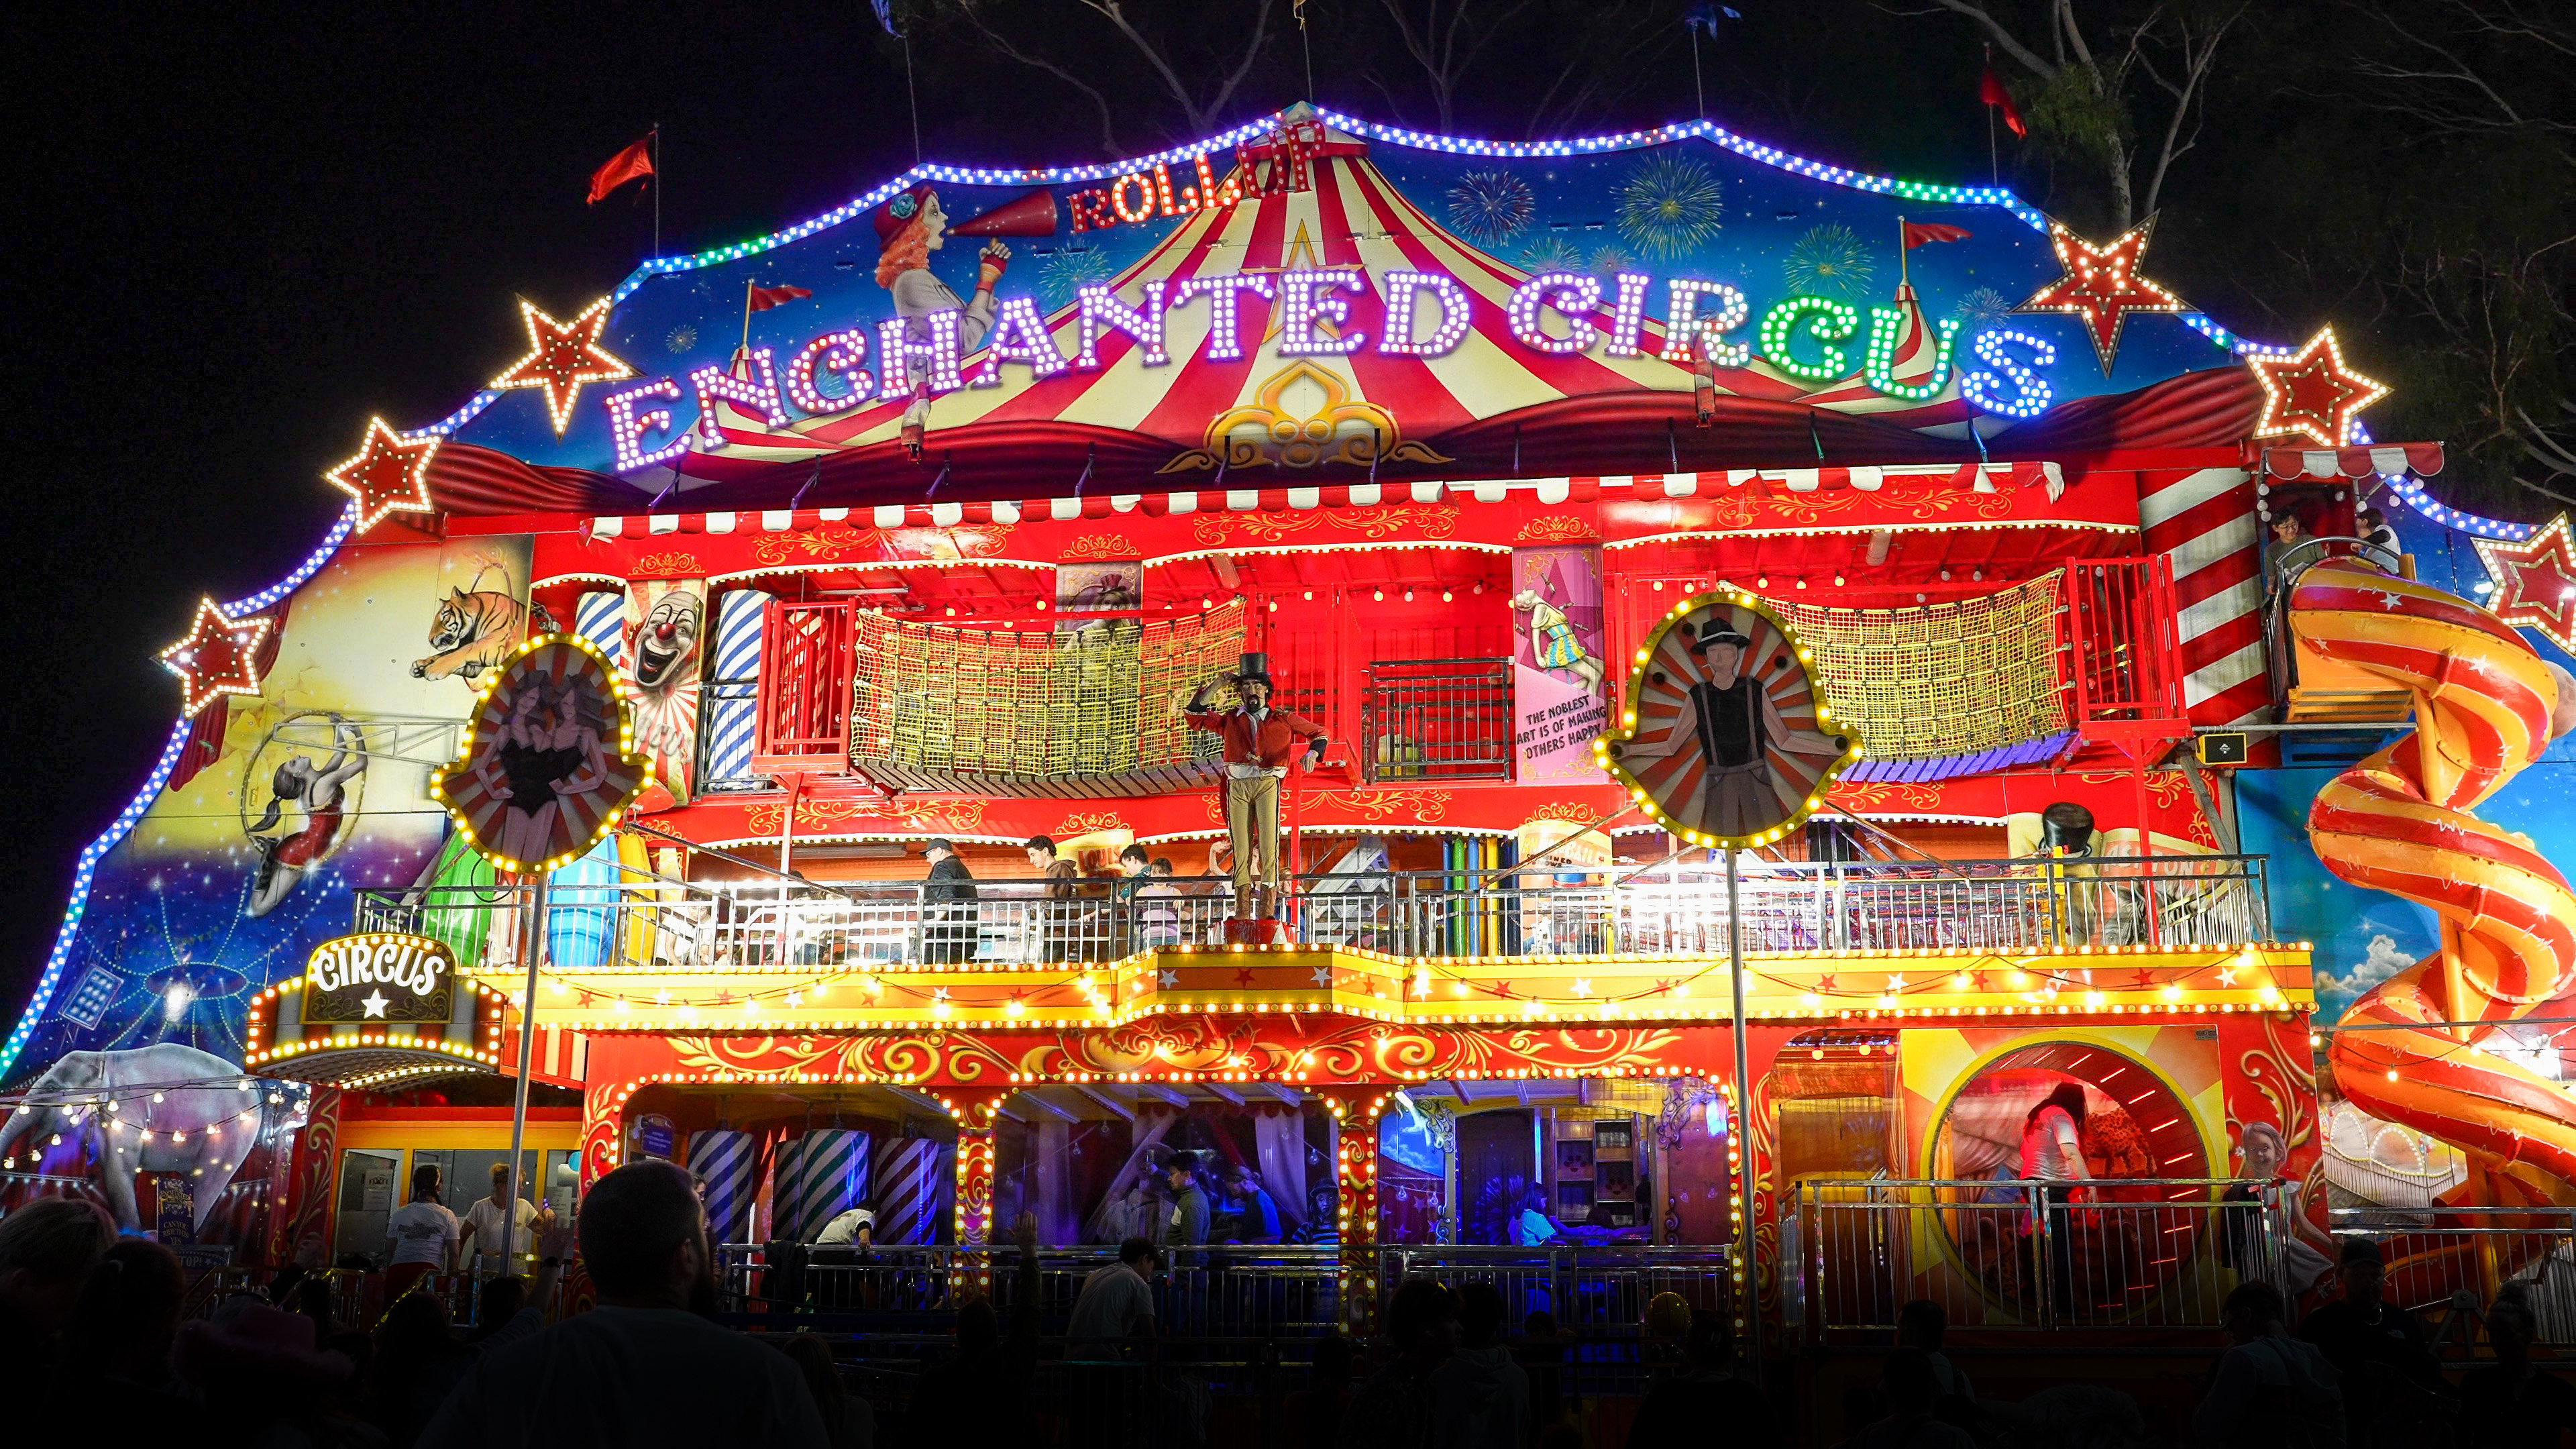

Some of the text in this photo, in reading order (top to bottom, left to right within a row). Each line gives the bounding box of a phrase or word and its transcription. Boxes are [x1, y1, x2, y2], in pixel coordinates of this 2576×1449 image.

[1069, 119, 1326, 234] ROLL UP
[603, 268, 2057, 474] ENCHANTED CIRCUS
[1516, 706, 1607, 745] ART IS OF MAKING
[1526, 695, 1589, 725] THE NOBLEST
[1525, 723, 1601, 759] OTHERS HAPPY
[313, 943, 445, 996] CIRCUS
[178, 1256, 203, 1267] TOP!
